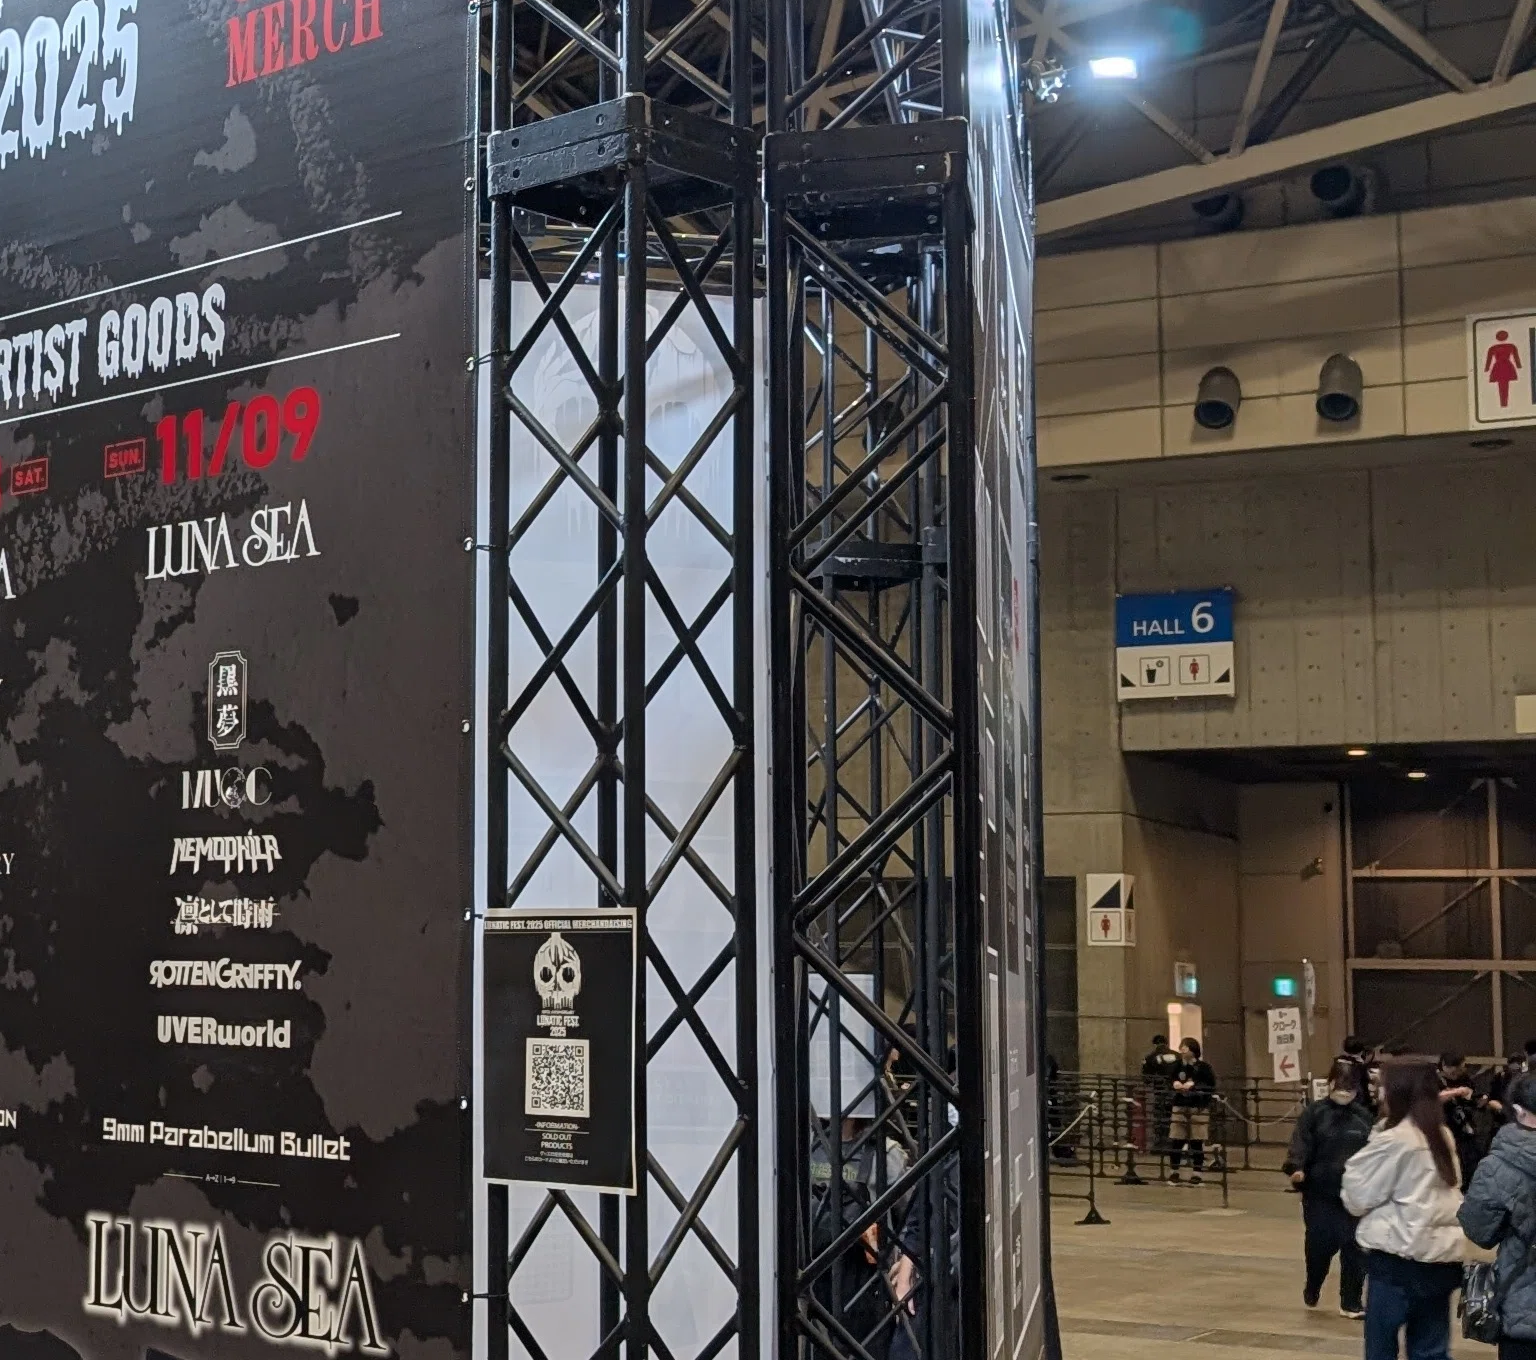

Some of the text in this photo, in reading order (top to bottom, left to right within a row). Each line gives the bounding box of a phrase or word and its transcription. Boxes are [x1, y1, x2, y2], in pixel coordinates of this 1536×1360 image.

[97, 282, 226, 385] GOODS
[109, 384, 322, 486] SUN. 11/09
[14, 466, 44, 488] SAT.
[145, 497, 321, 581] LUNA SEA
[1133, 601, 1214, 636] HALL 6
[169, 829, 283, 875] NEMOPHILA
[157, 1015, 291, 1048] UVERworld
[103, 1117, 351, 1161] 9mm Parabellum Bullet
[88, 1217, 390, 1352] LUNA SEA
